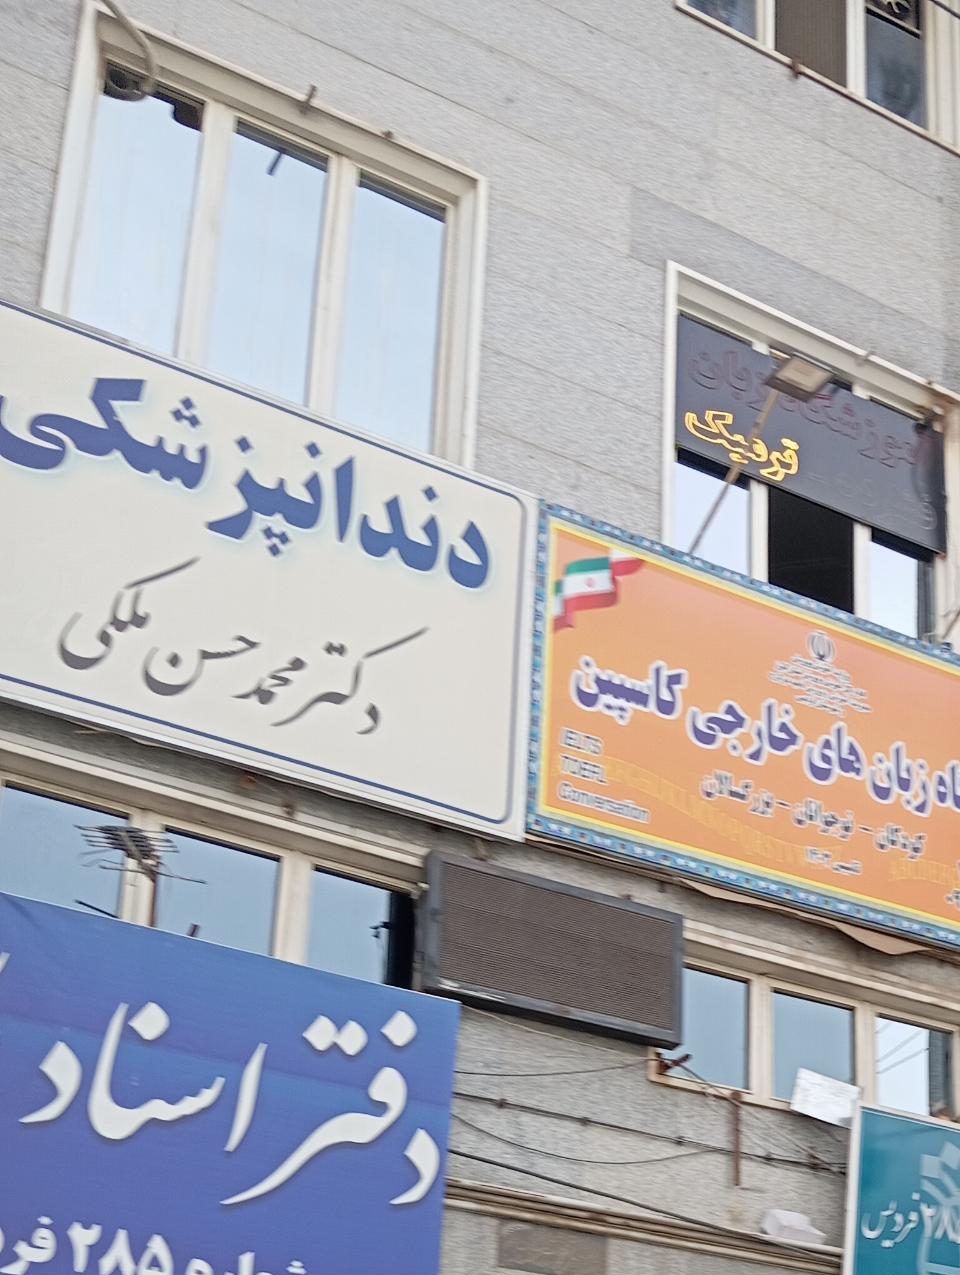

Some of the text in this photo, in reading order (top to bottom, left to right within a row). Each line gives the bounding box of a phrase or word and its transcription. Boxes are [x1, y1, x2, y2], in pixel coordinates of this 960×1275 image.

[0, 378, 490, 589] دندانپزشکی
[58, 556, 430, 735] دکتر محمد حسن ملکی
[571, 657, 687, 725] کاسپین
[687, 699, 802, 764] خارجی
[806, 724, 863, 783] های
[870, 743, 930, 815] زبان
[18, 1001, 441, 1205] دفتر اسناد
[0, 1216, 57, 1275] فر
[861, 1191, 920, 1248] فردیس
